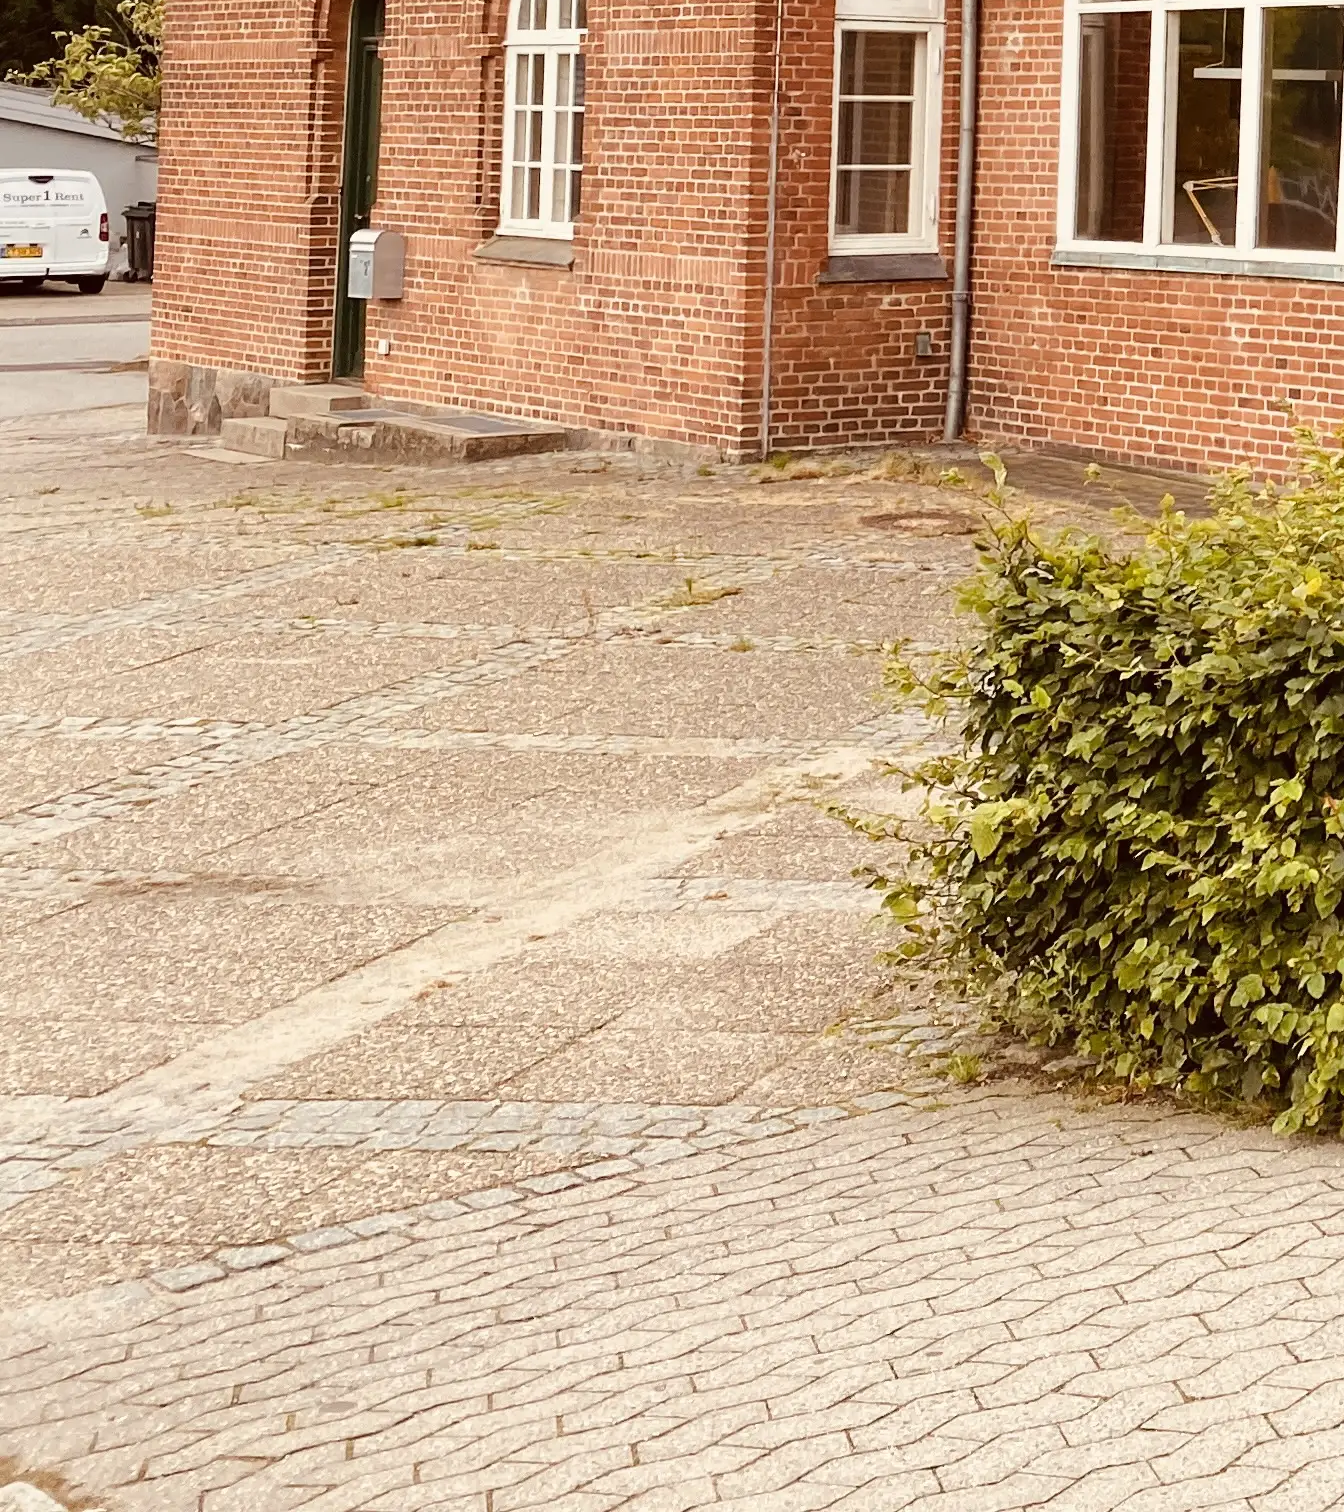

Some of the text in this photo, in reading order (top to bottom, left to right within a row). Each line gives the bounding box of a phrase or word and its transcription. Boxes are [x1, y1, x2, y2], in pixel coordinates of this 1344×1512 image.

[3, 190, 84, 204] Super 1 Rent
